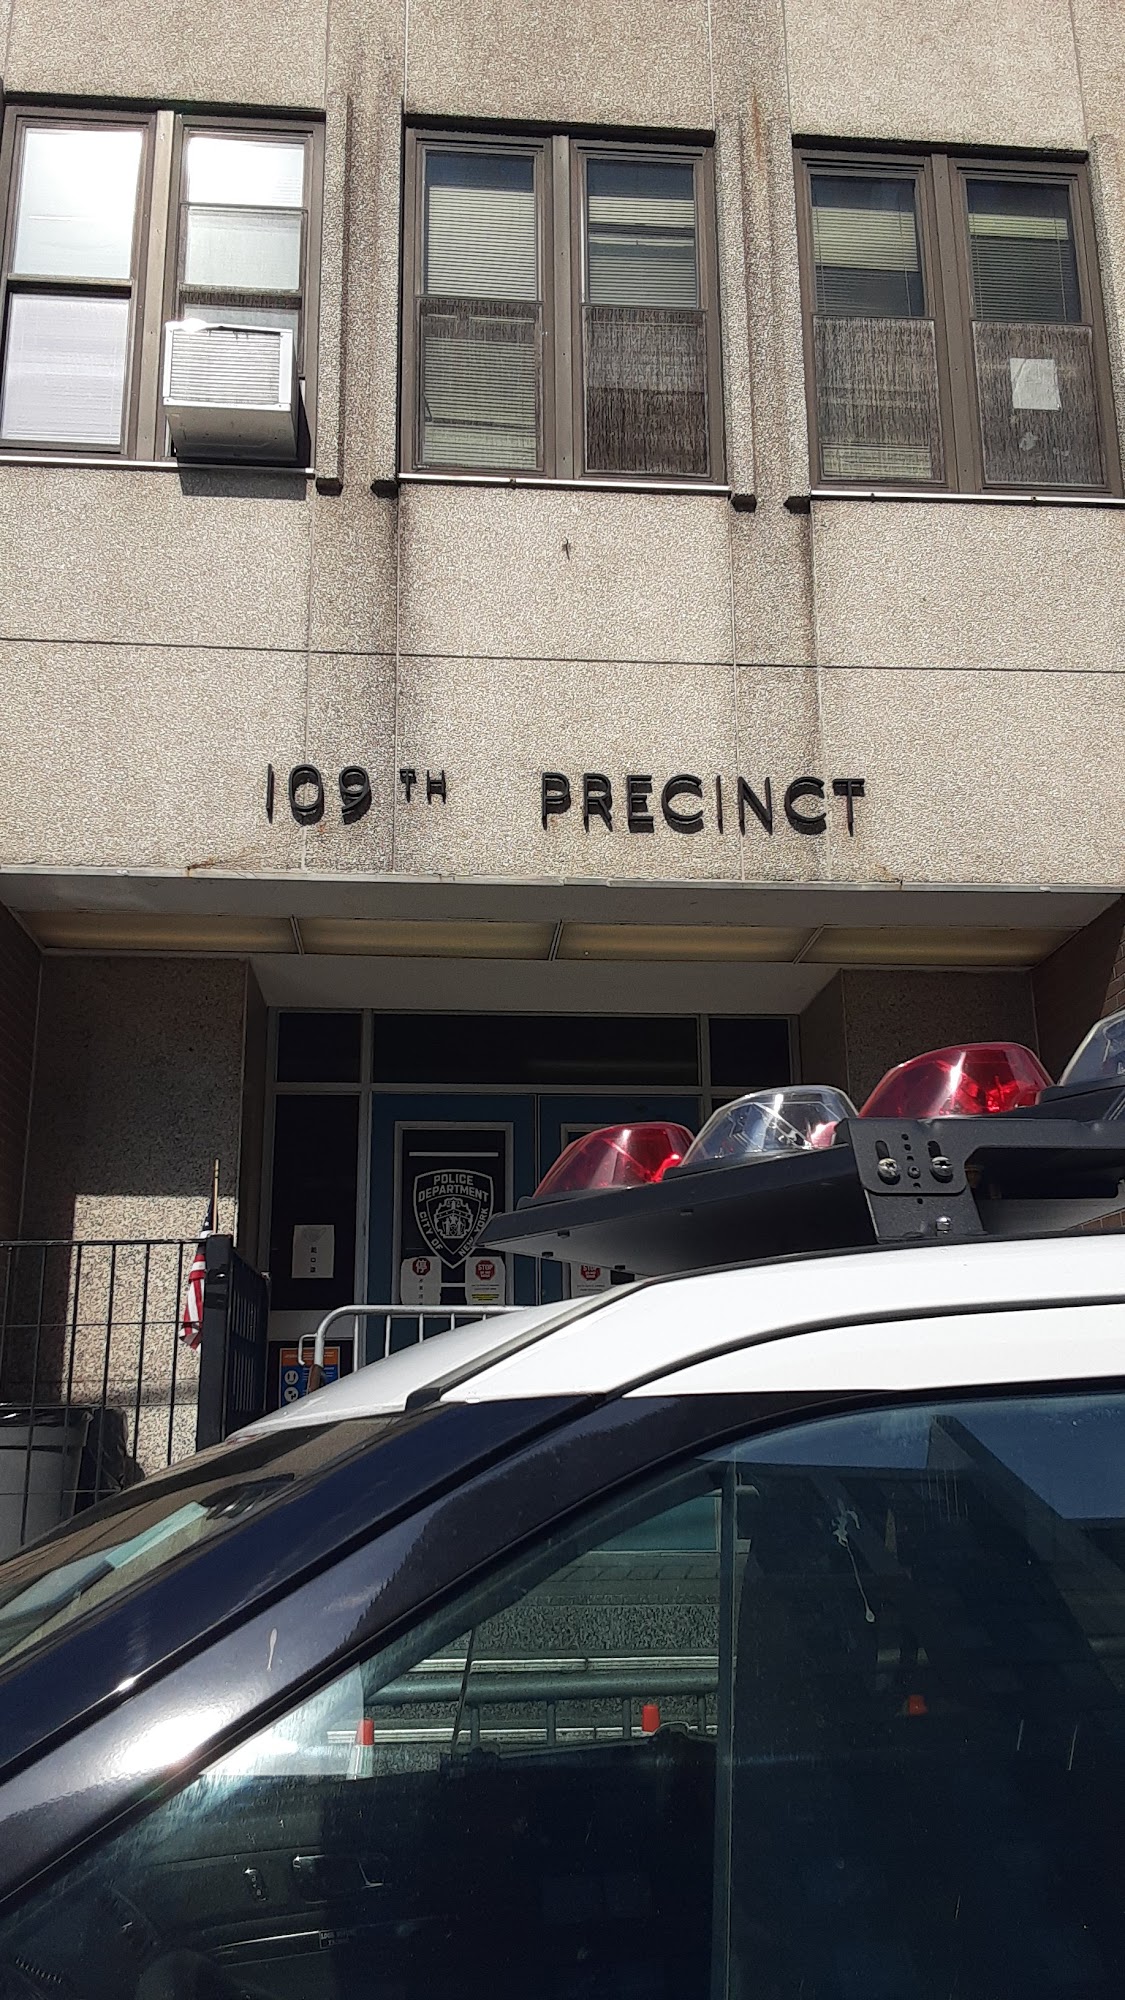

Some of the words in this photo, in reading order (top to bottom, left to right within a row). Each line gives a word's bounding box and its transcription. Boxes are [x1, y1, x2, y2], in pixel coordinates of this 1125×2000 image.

[541, 771, 866, 837] PRECINCT
[418, 1184, 489, 1203] DEPARTMENT
[433, 1173, 474, 1186] POLICE
[420, 1211, 433, 1235] CITY
[431, 1238, 443, 1250] OF
[458, 1236, 474, 1257] NEW
[474, 1207, 489, 1233] YORK
